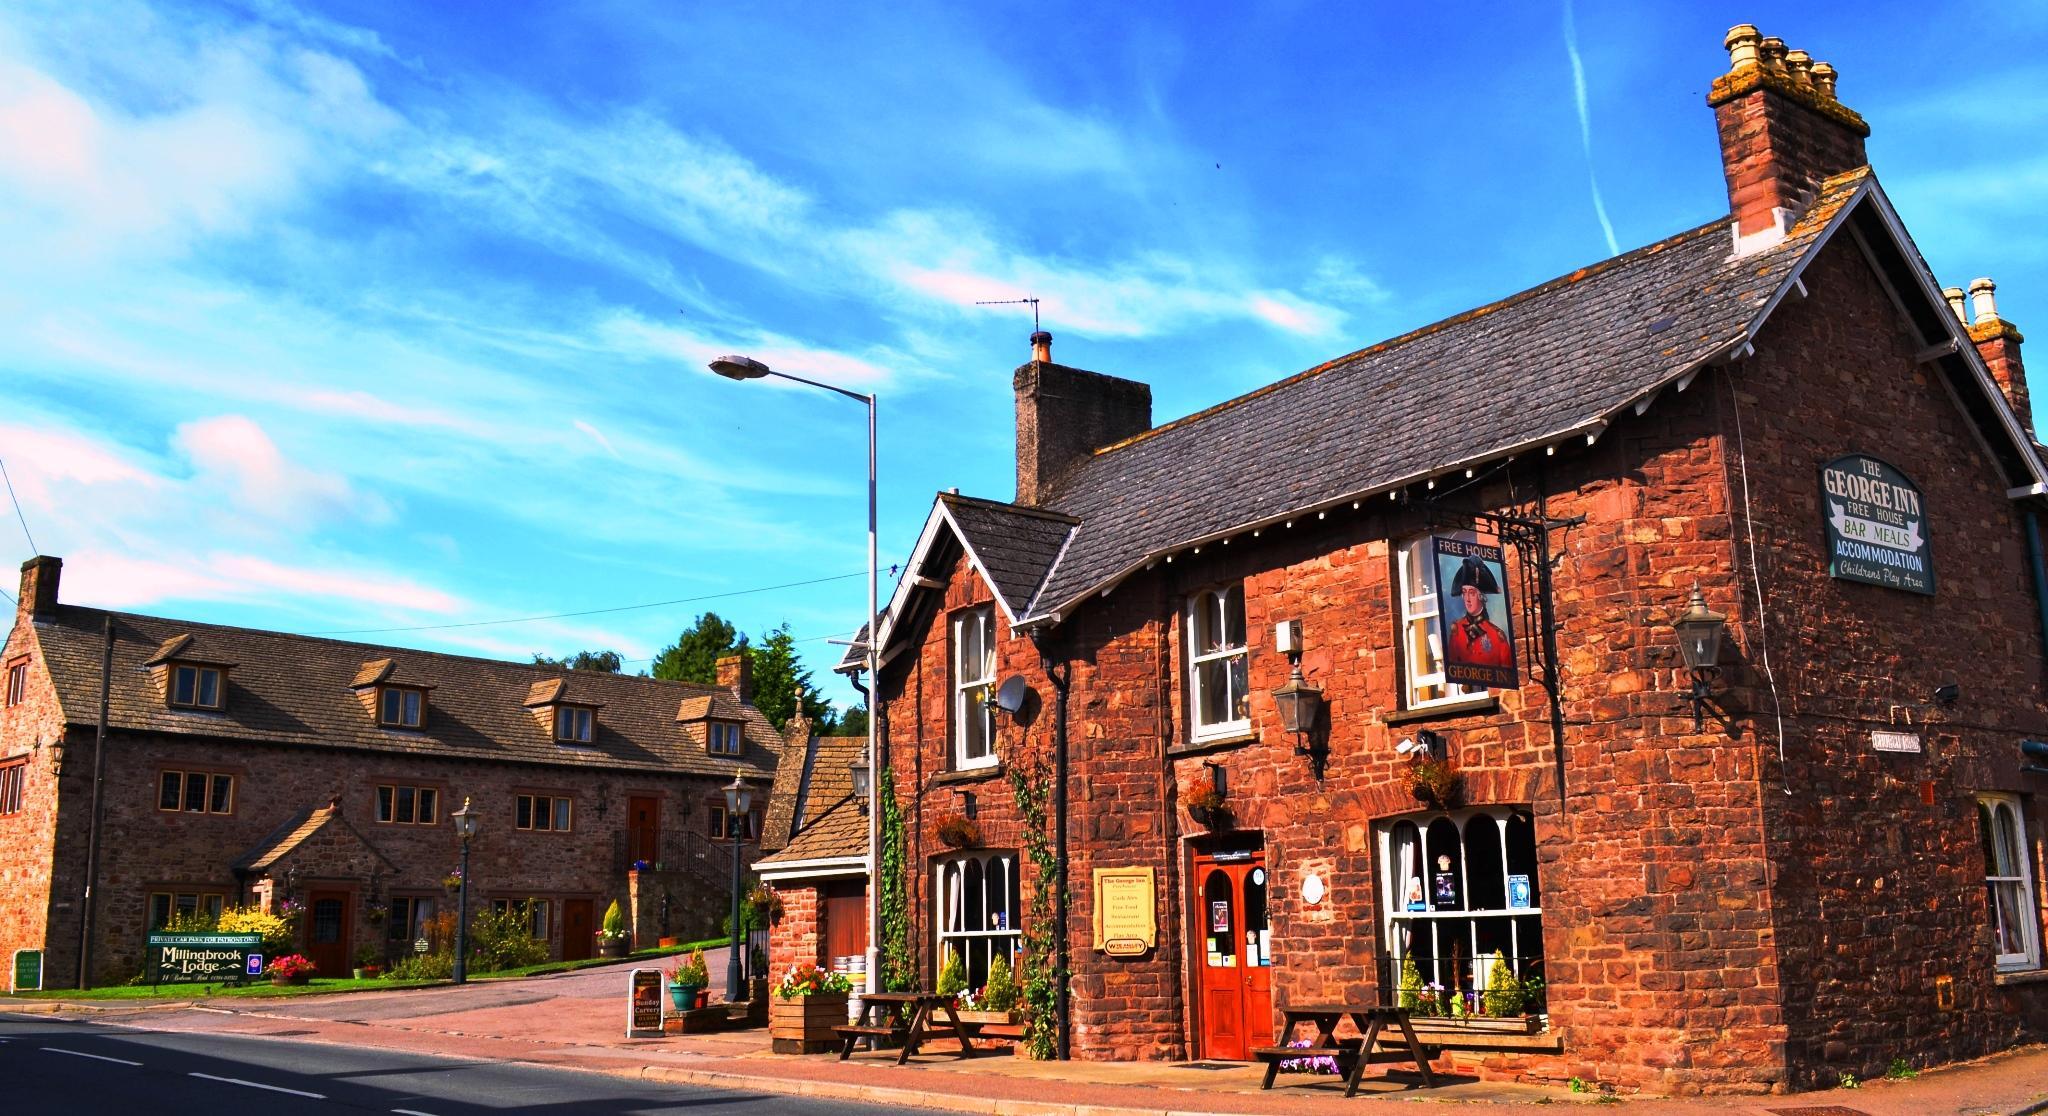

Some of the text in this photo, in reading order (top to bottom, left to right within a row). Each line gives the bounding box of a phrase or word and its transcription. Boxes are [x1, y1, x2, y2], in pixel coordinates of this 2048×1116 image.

[1860, 458, 1881, 478] THE
[1824, 468, 1920, 516] GEORGE INN
[1847, 502, 1904, 526] FREE HOUSE
[1844, 519, 1910, 547] BAR MEALS
[1439, 540, 1499, 560] FREE HOUSE
[1836, 539, 1923, 572] ACCOMMODATION
[1883, 568, 1900, 586] Play
[1903, 573, 1923, 588] Area
[1448, 664, 1493, 681] GEORGE
[161, 947, 241, 963] Millingbrook
[182, 960, 220, 974] Lodge
[635, 999, 660, 1007] Sunday
